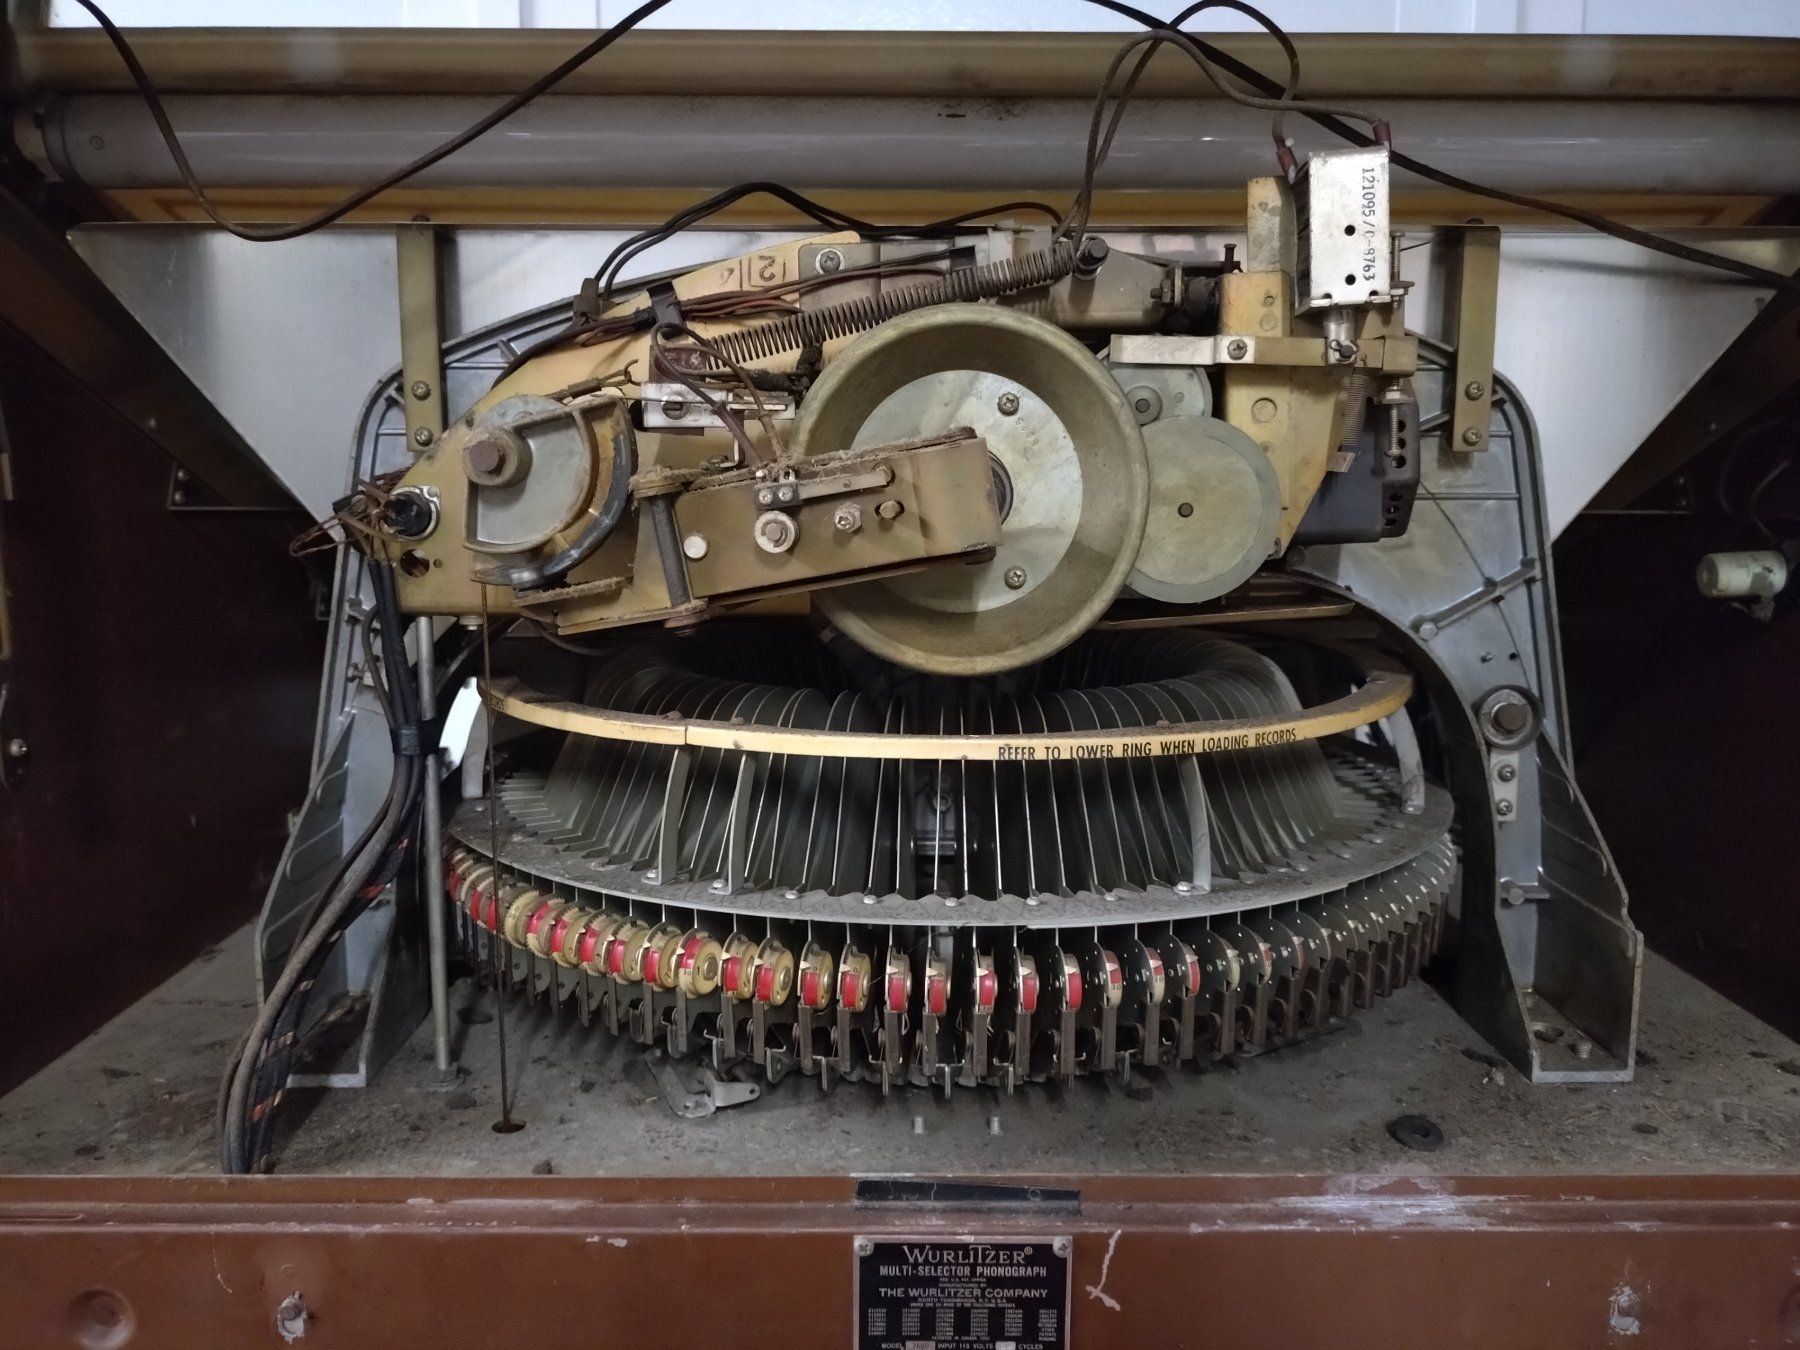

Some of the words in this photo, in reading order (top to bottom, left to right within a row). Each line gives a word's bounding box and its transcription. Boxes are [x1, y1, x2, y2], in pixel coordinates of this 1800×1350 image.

[999, 745, 1036, 760] REFER
[1045, 745, 1061, 760] TO
[1070, 743, 1114, 759] LOWER
[1122, 741, 1152, 757] RING
[1160, 739, 1195, 755] WHEN
[1202, 734, 1249, 752] LOADING
[1255, 727, 1297, 746] RECORDS
[879, 1265, 971, 1276] MULTI-SELECTOR
[976, 1265, 1047, 1277] PHONOGRAPH
[878, 1287, 905, 1298] THE
[908, 1287, 981, 1298] WURLITZER
[984, 1288, 1048, 1298] COMPANY
[972, 1342, 993, 1350] VOLTS
